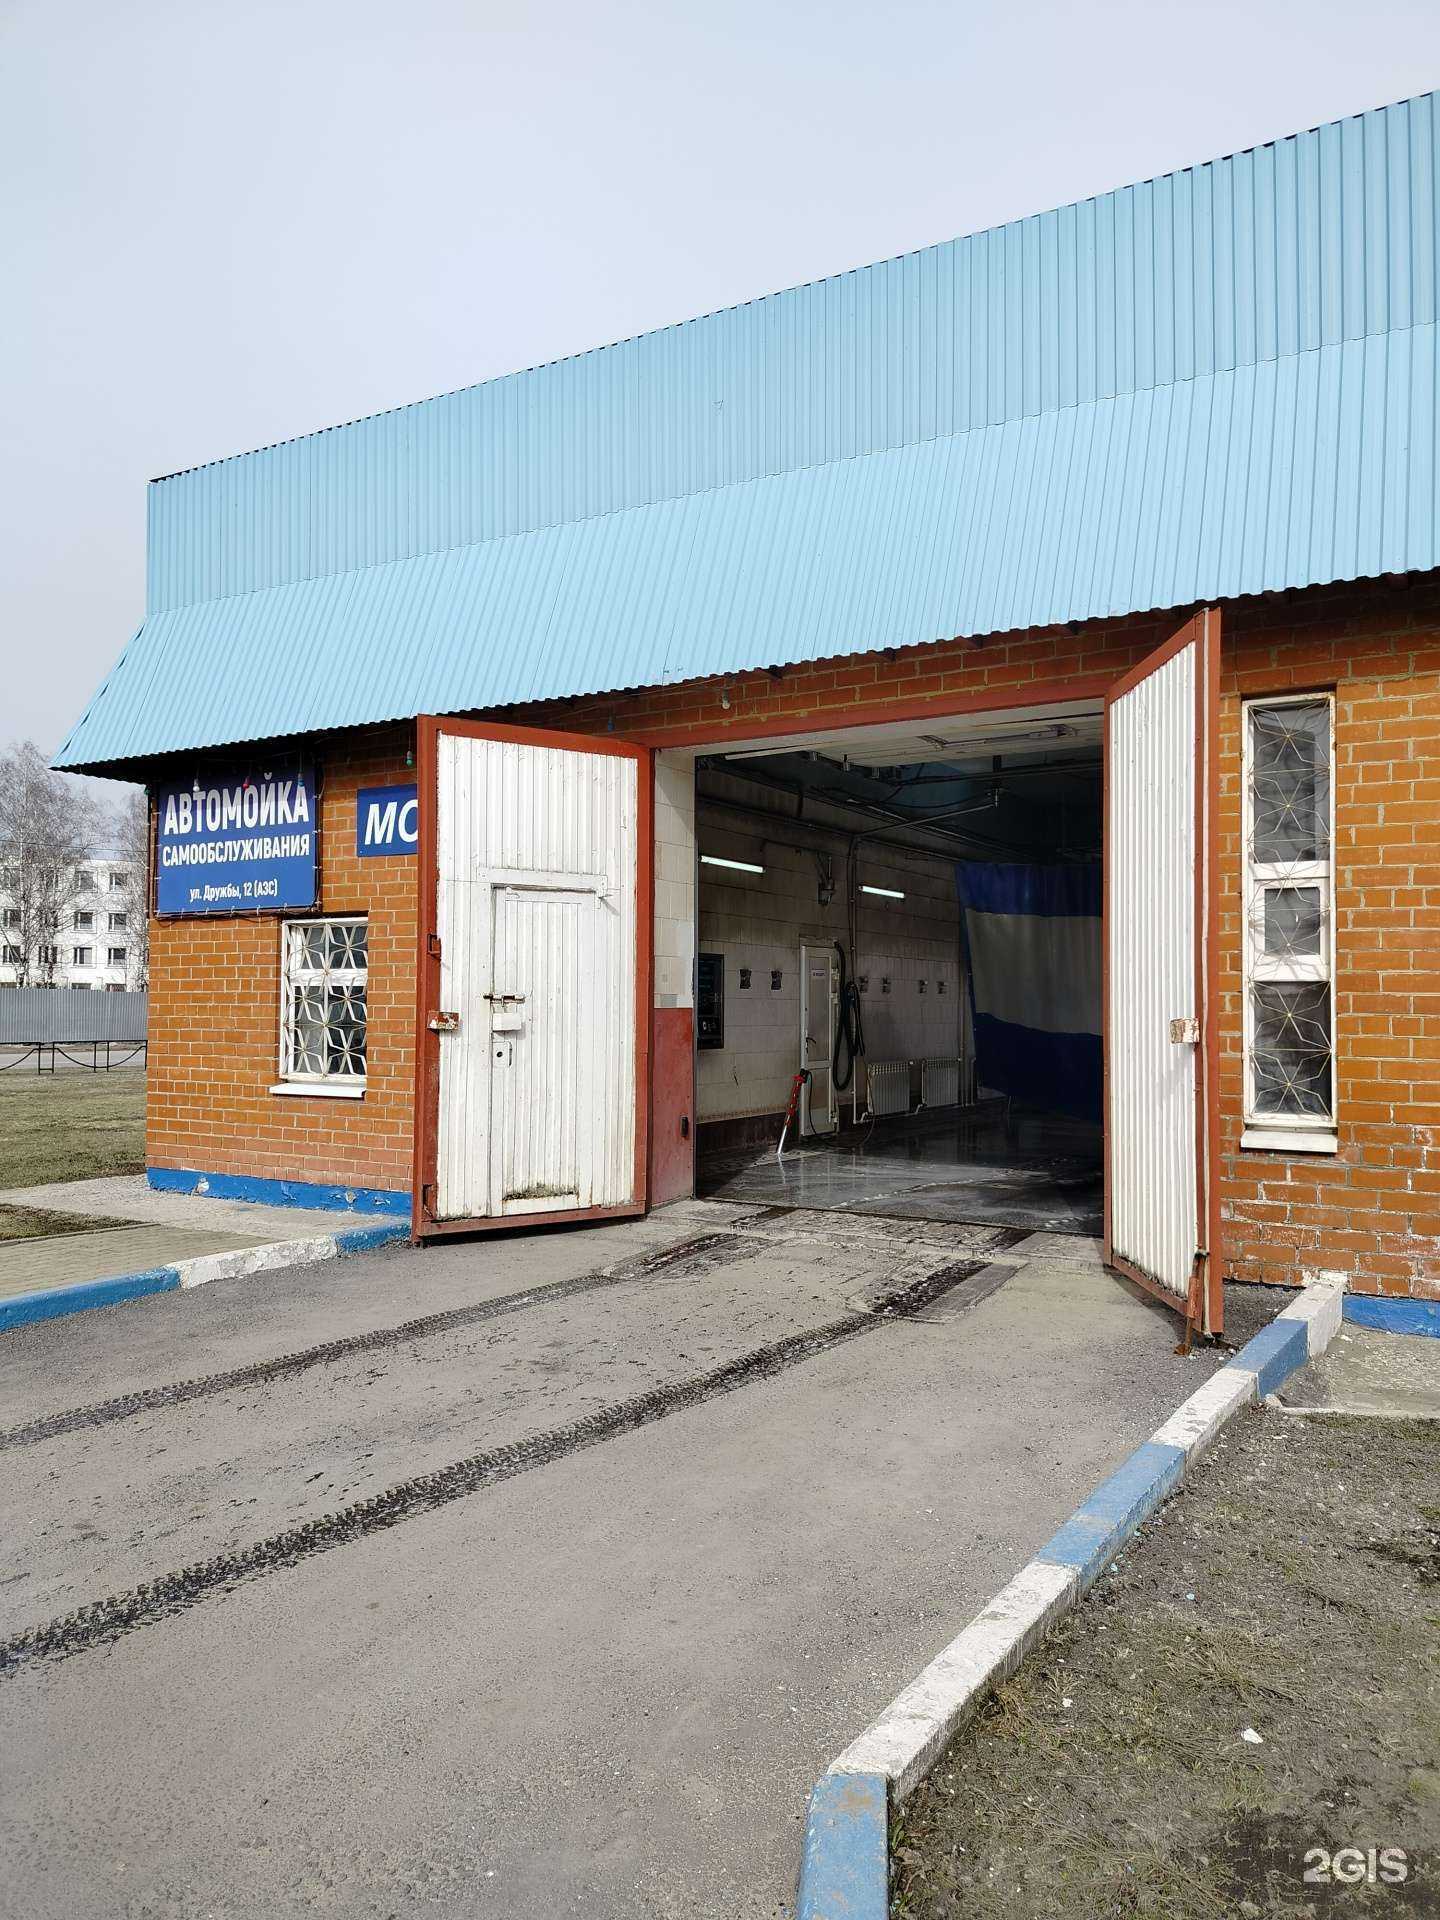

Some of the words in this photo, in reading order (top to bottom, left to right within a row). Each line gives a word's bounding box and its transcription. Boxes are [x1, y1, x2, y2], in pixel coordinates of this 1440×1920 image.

[164, 772, 309, 835] АВТОМОЙКА
[162, 834, 310, 867] САМООБСЛУЖИВАНИЯ
[189, 888, 202, 904] ул.
[203, 883, 242, 901] Дружбы,
[243, 881, 253, 897] 12
[253, 878, 278, 898] (АЗС)
